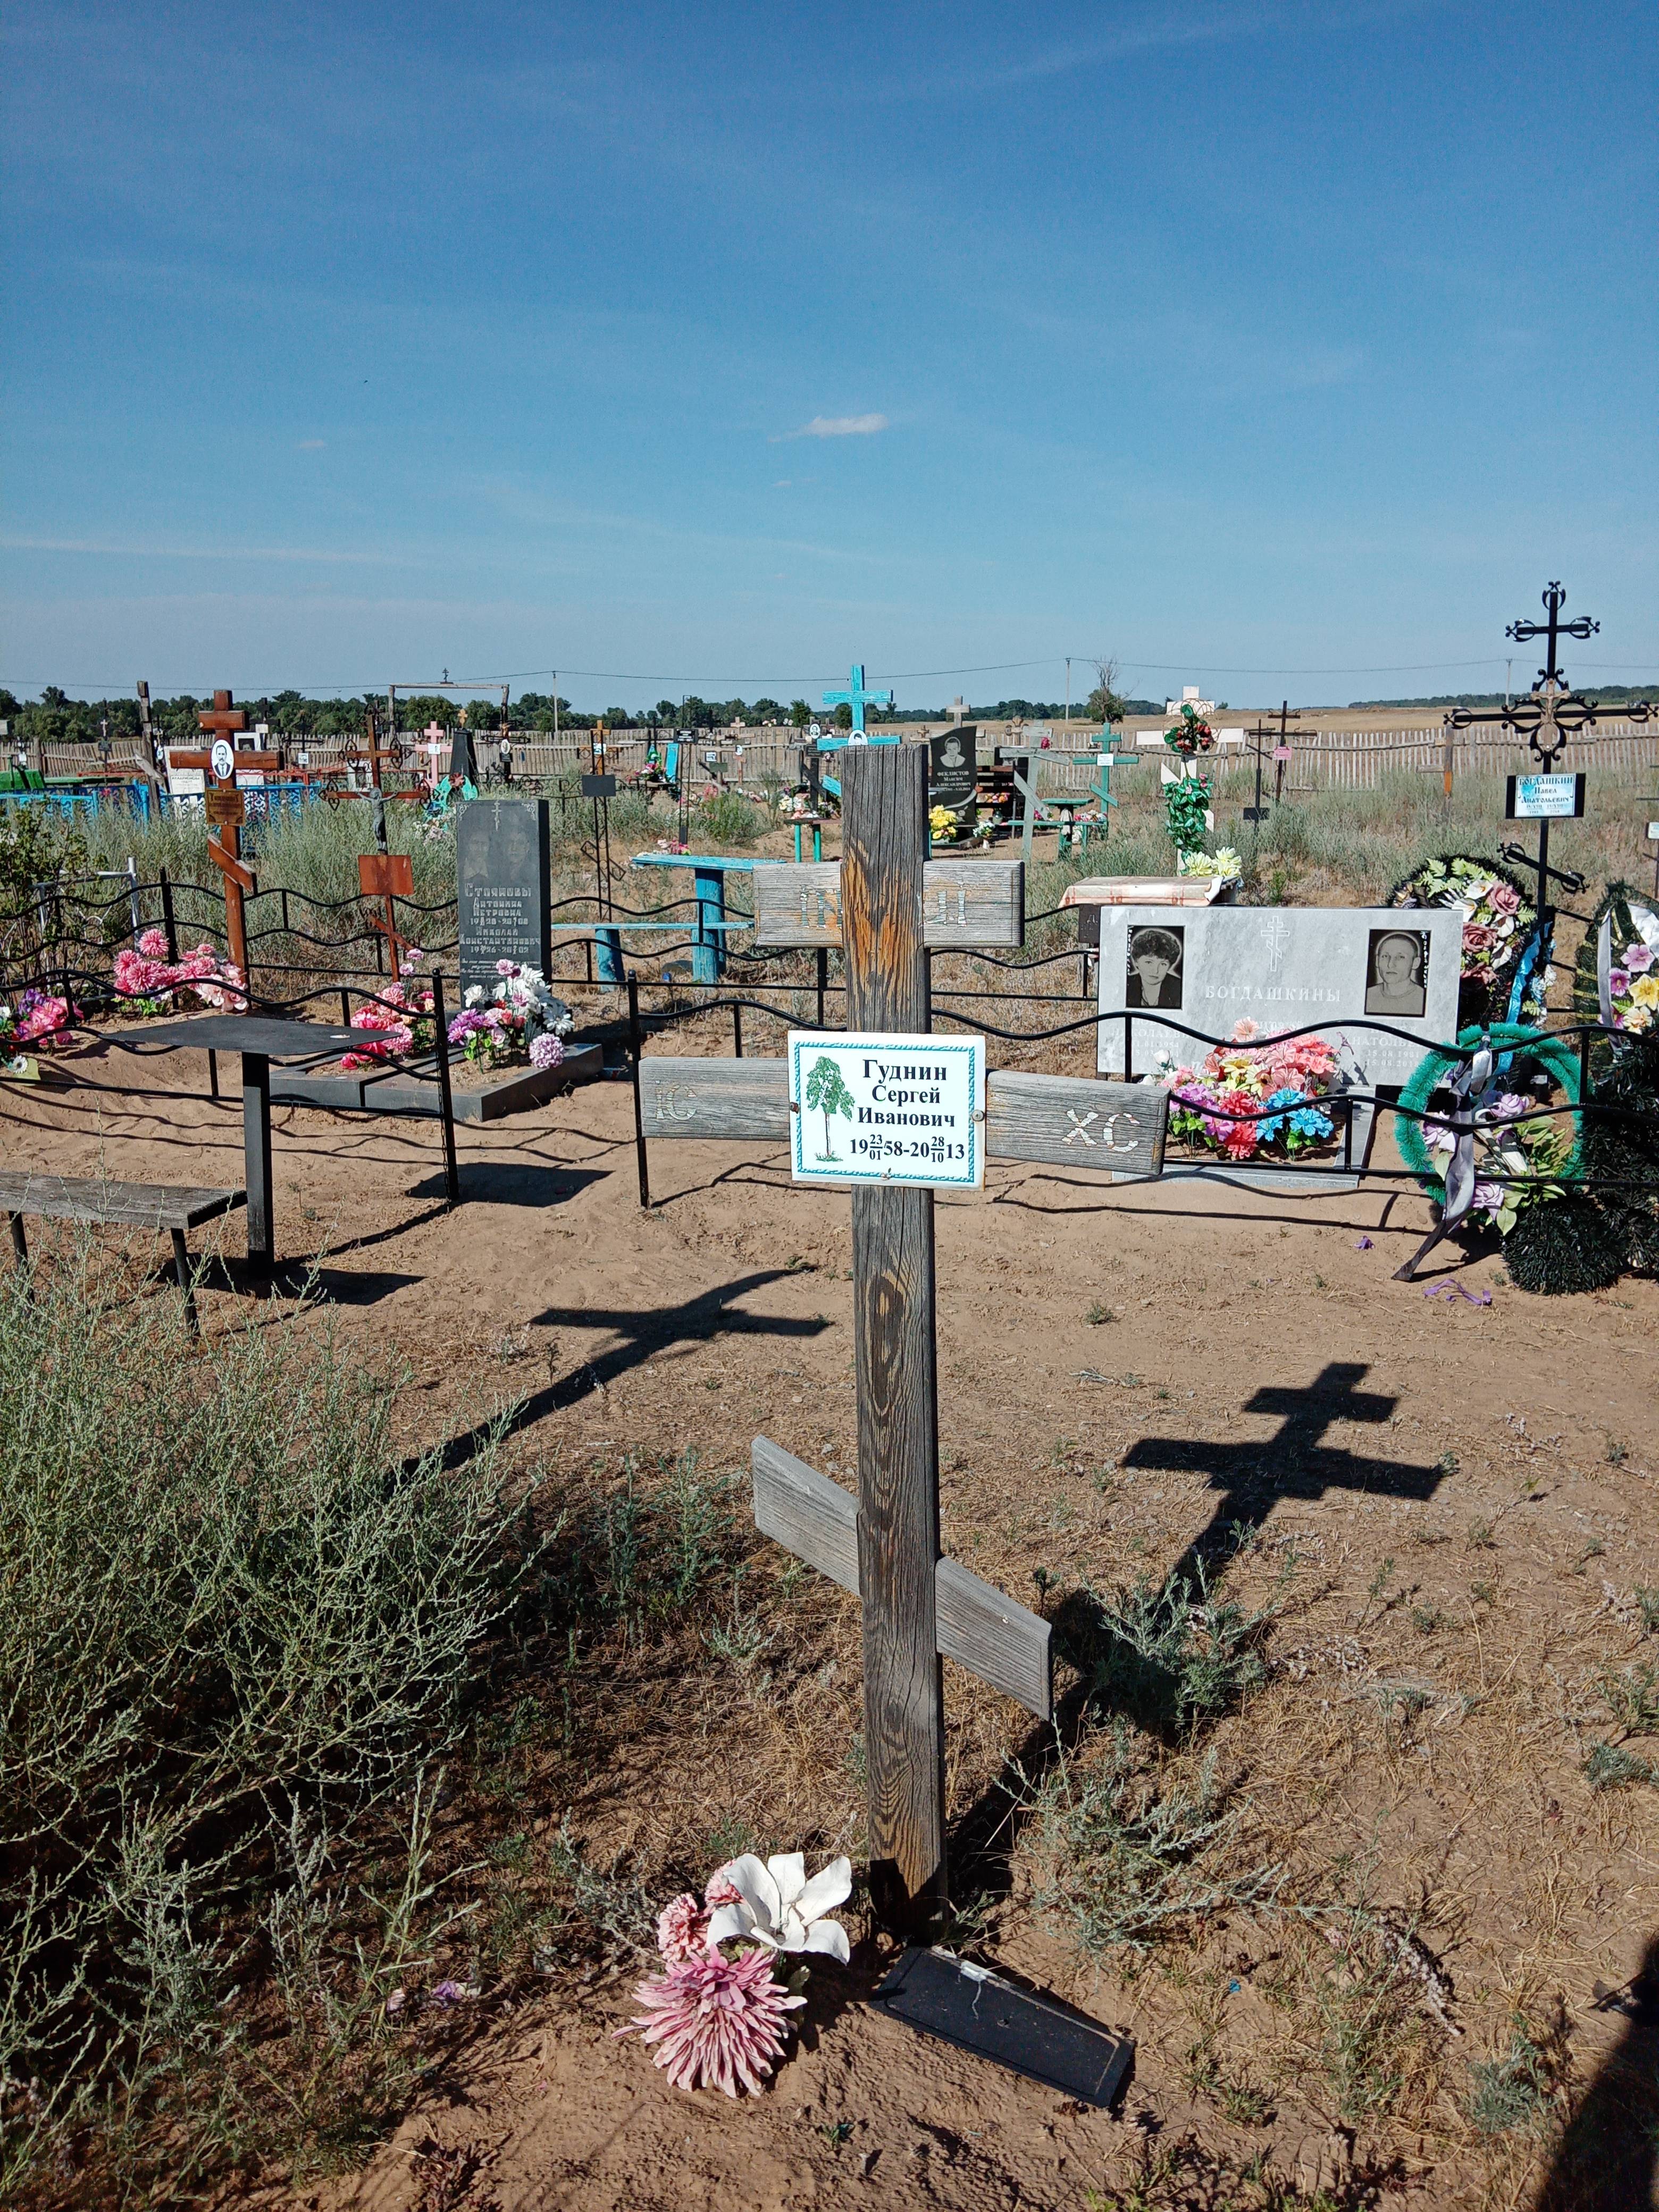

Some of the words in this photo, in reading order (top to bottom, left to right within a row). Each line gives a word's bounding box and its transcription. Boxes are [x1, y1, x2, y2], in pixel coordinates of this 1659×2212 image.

[1205, 985, 1341, 1002] БОГДАШКИНЫ
[862, 1059, 947, 1084] Гуднин
[872, 1085, 941, 1107] Сергей
[857, 1107, 955, 1127] Иванович
